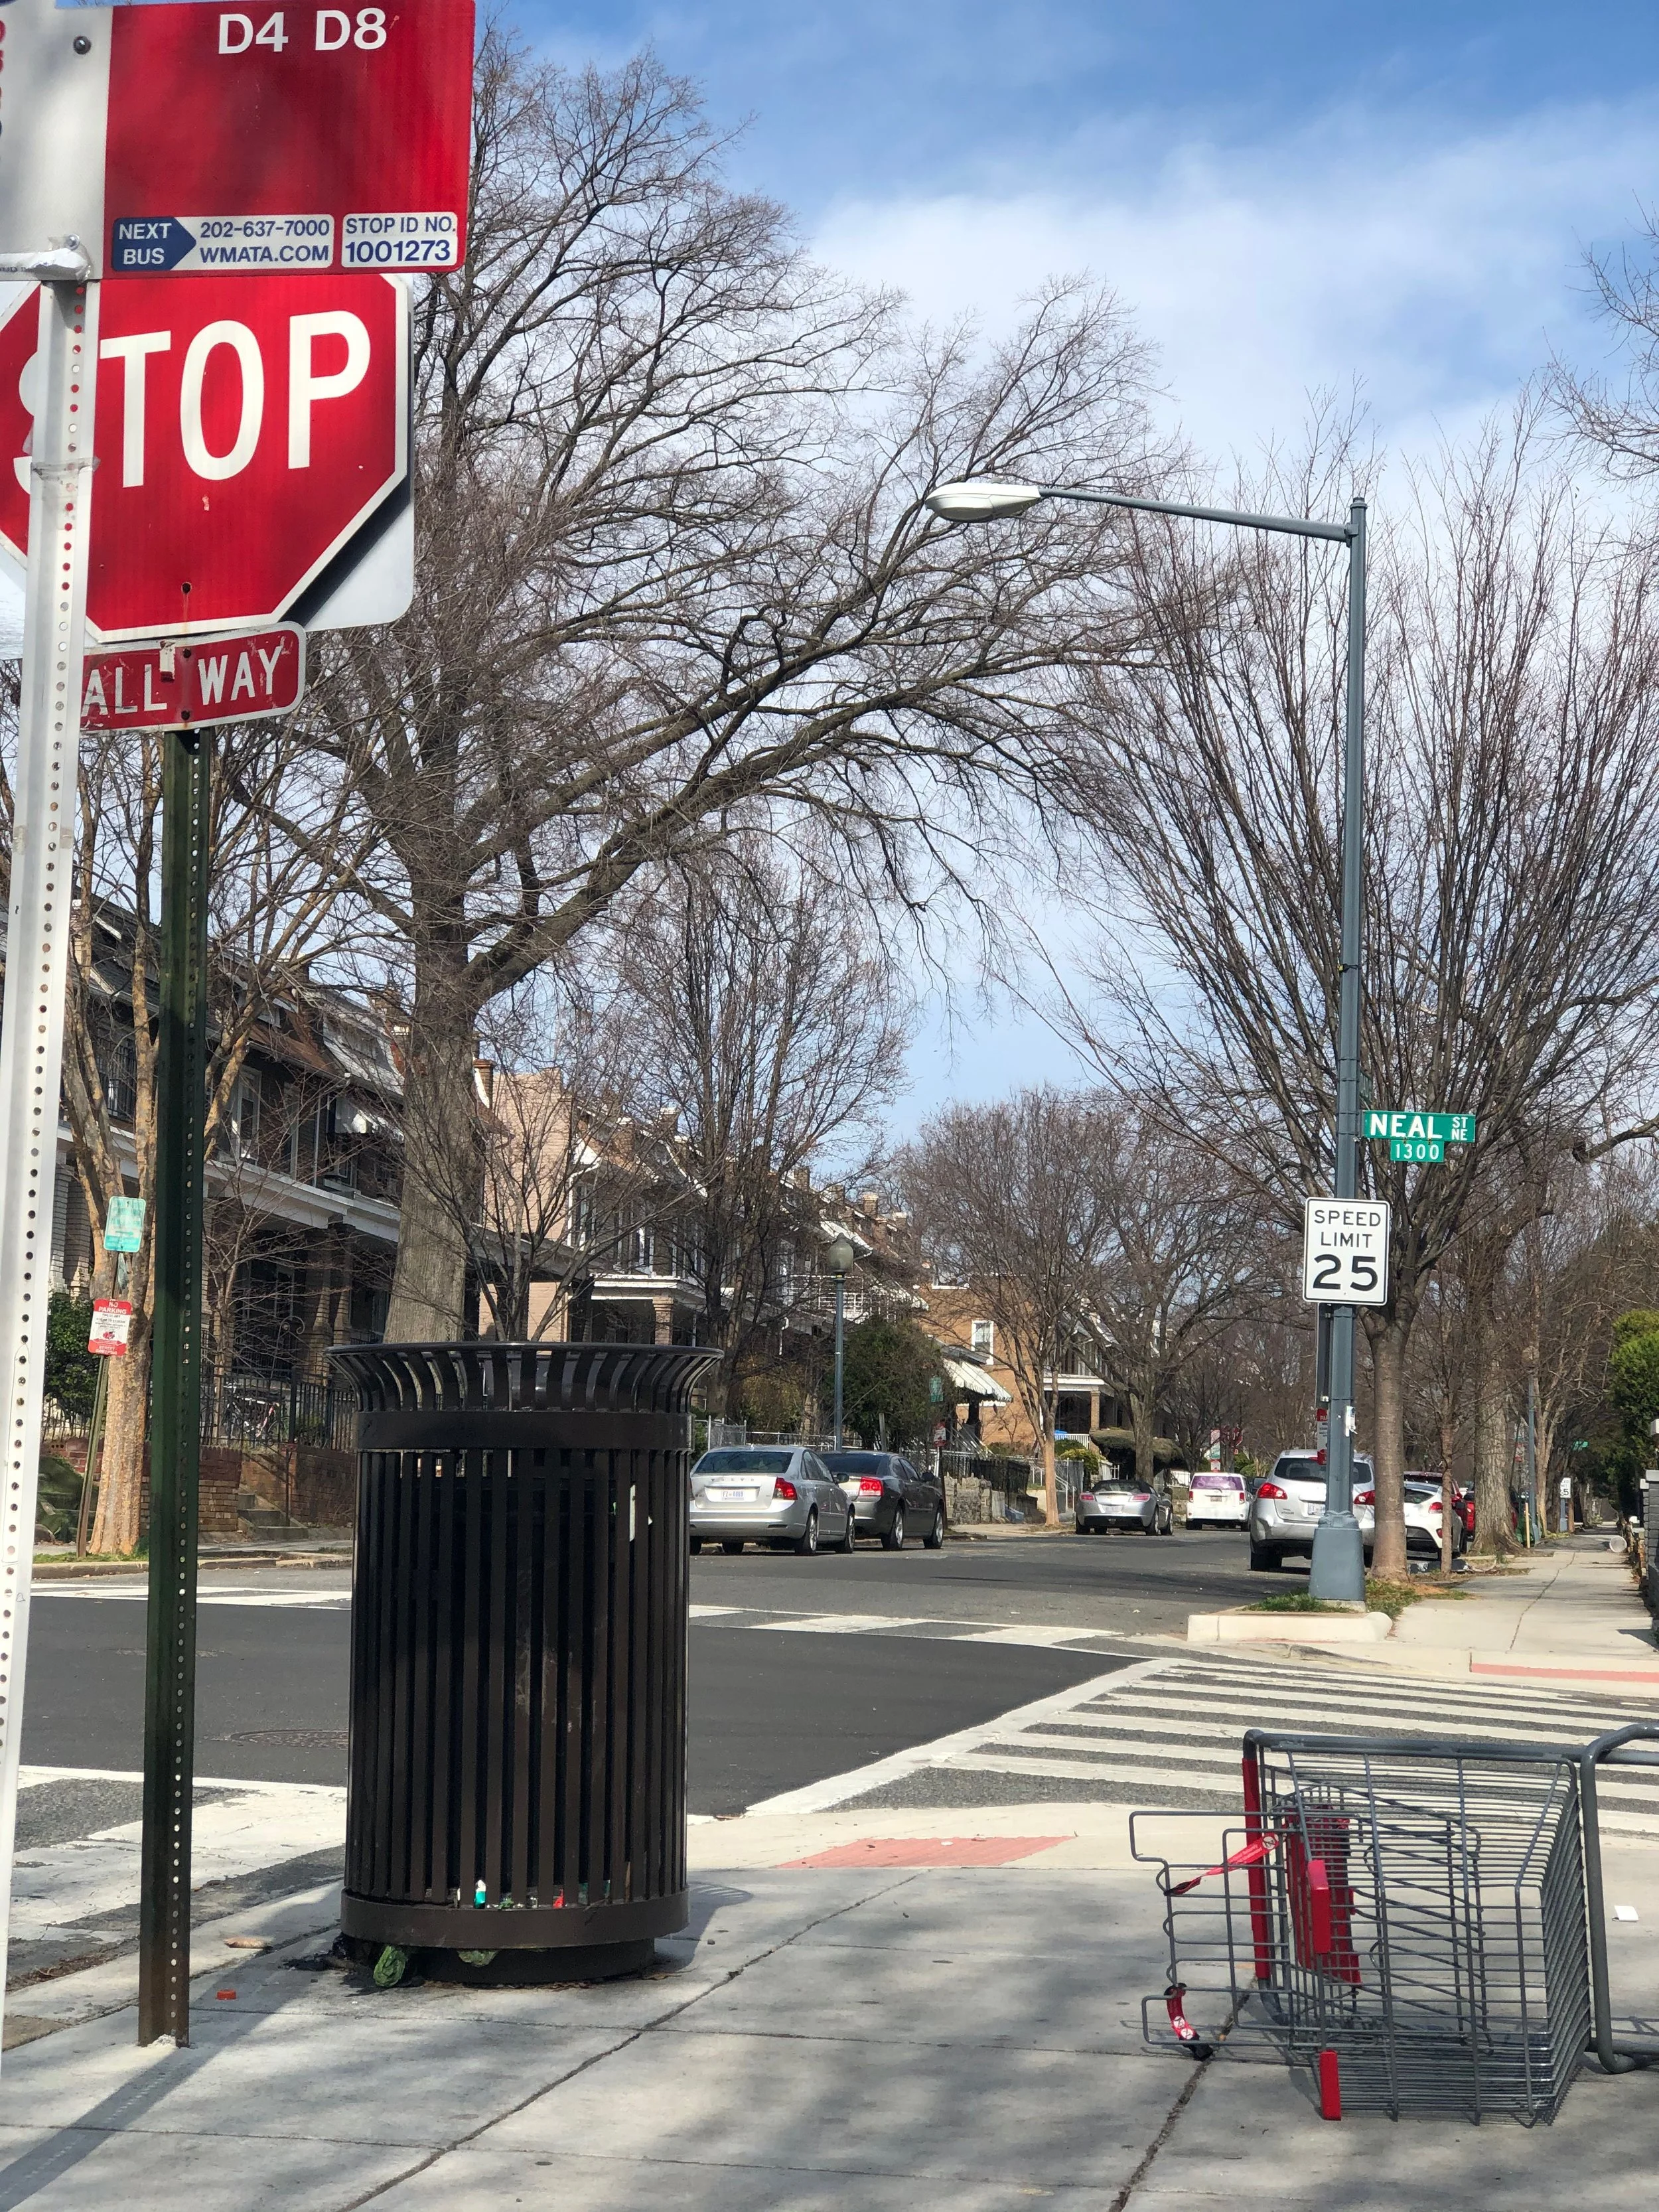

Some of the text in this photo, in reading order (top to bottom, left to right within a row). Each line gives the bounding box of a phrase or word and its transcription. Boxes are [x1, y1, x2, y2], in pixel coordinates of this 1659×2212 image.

[218, 7, 386, 54] D4 D8
[118, 222, 172, 241] NEXT
[200, 218, 329, 238] 202-637-7000
[345, 216, 457, 234] STOP ID NO.
[123, 247, 165, 265] BUS
[200, 245, 329, 263] WMATA.COM
[345, 240, 450, 263] 1001273
[81, 646, 281, 717] ALL WAY
[1370, 1113, 1469, 1139] NEAL ST
[1451, 1129, 1468, 1141] NE
[1396, 1143, 1439, 1160] 1300
[1314, 1209, 1381, 1227] SPEED
[1321, 1231, 1372, 1248] LIMIT
[1313, 1254, 1378, 1291] 25
[98, 1306, 127, 1315] PARKING
